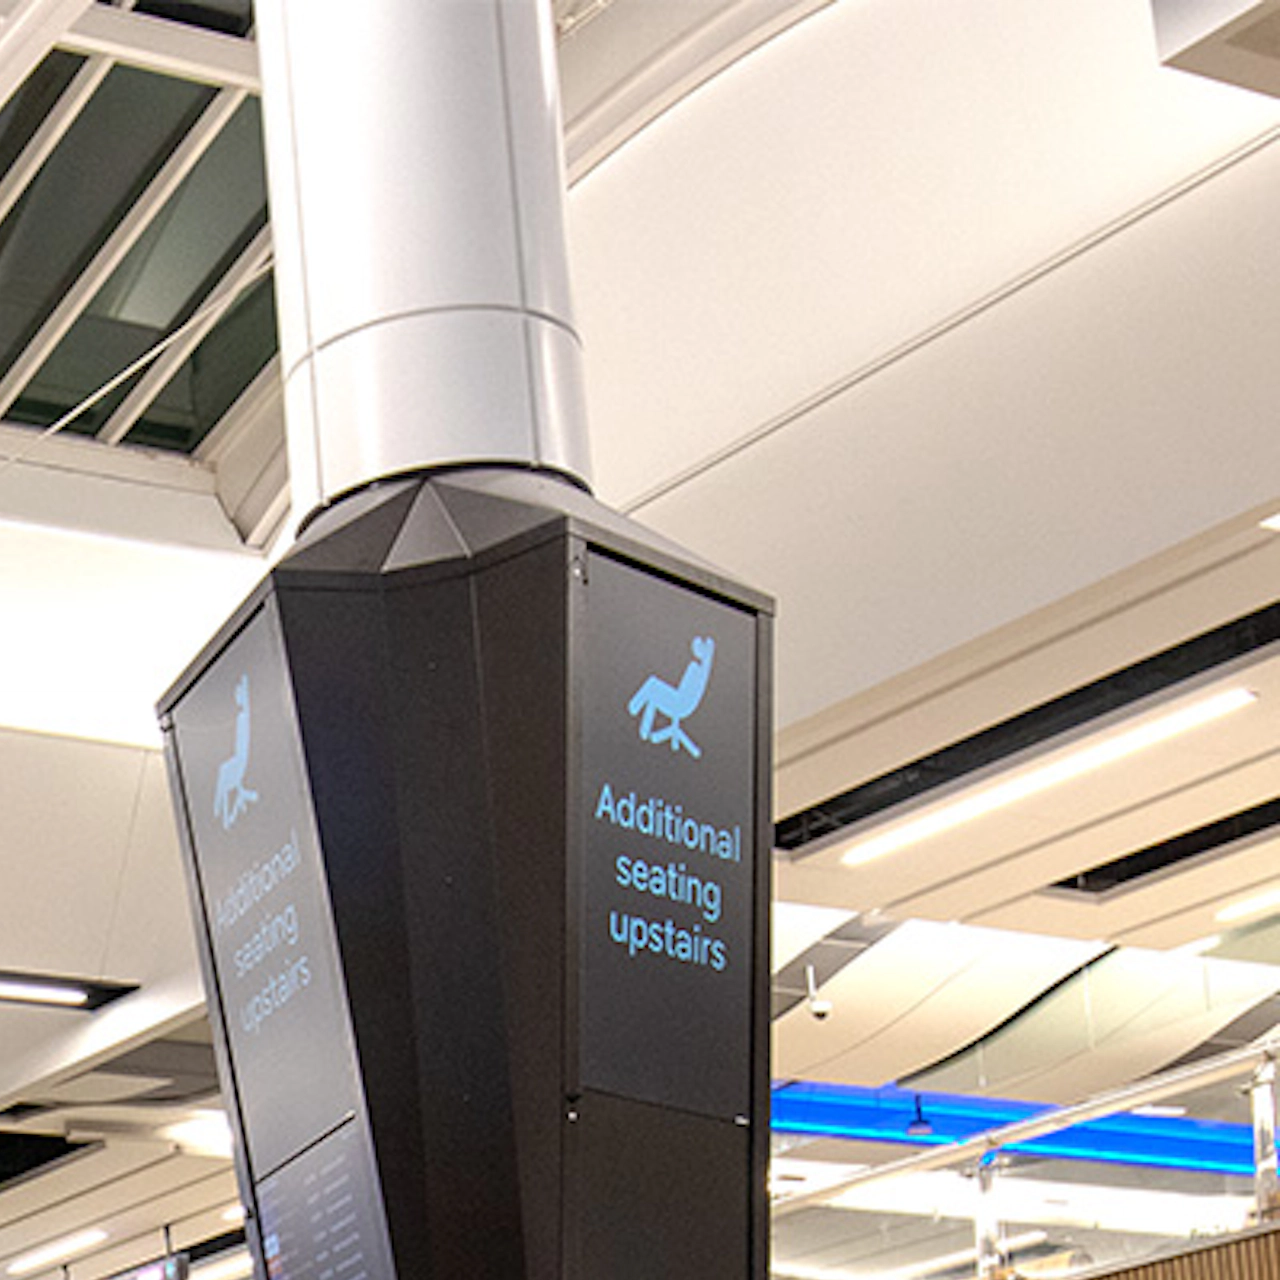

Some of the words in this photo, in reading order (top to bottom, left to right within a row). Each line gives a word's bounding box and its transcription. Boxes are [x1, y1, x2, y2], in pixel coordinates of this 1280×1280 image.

[595, 783, 741, 862] Additional
[217, 826, 300, 933] Additional
[615, 854, 722, 923] seating
[235, 903, 299, 977] seating
[609, 909, 727, 972] upstairs
[242, 955, 312, 1034] upstairs
